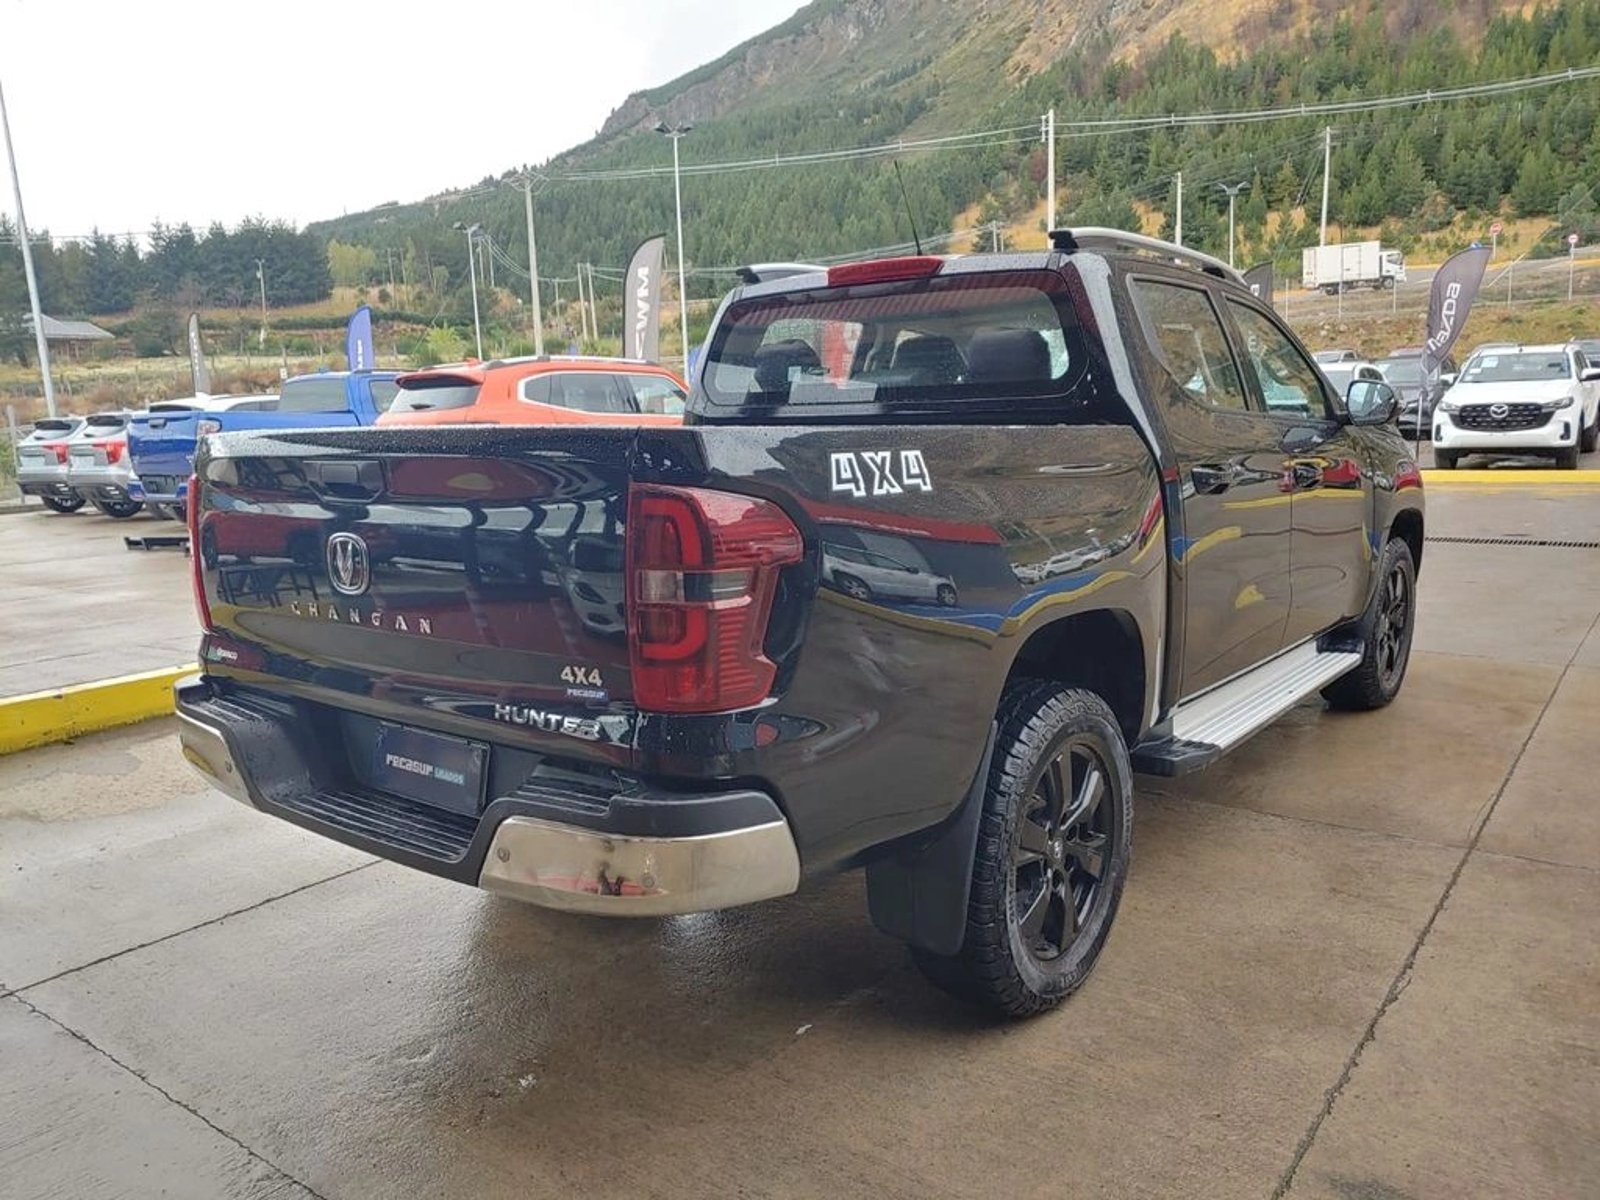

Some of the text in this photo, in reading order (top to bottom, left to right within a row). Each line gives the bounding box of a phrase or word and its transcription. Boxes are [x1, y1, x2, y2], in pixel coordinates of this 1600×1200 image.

[830, 450, 933, 497] 4X4
[291, 601, 432, 634] CHANGAN
[560, 665, 602, 686] 4X4
[494, 703, 601, 741] HUNTER
